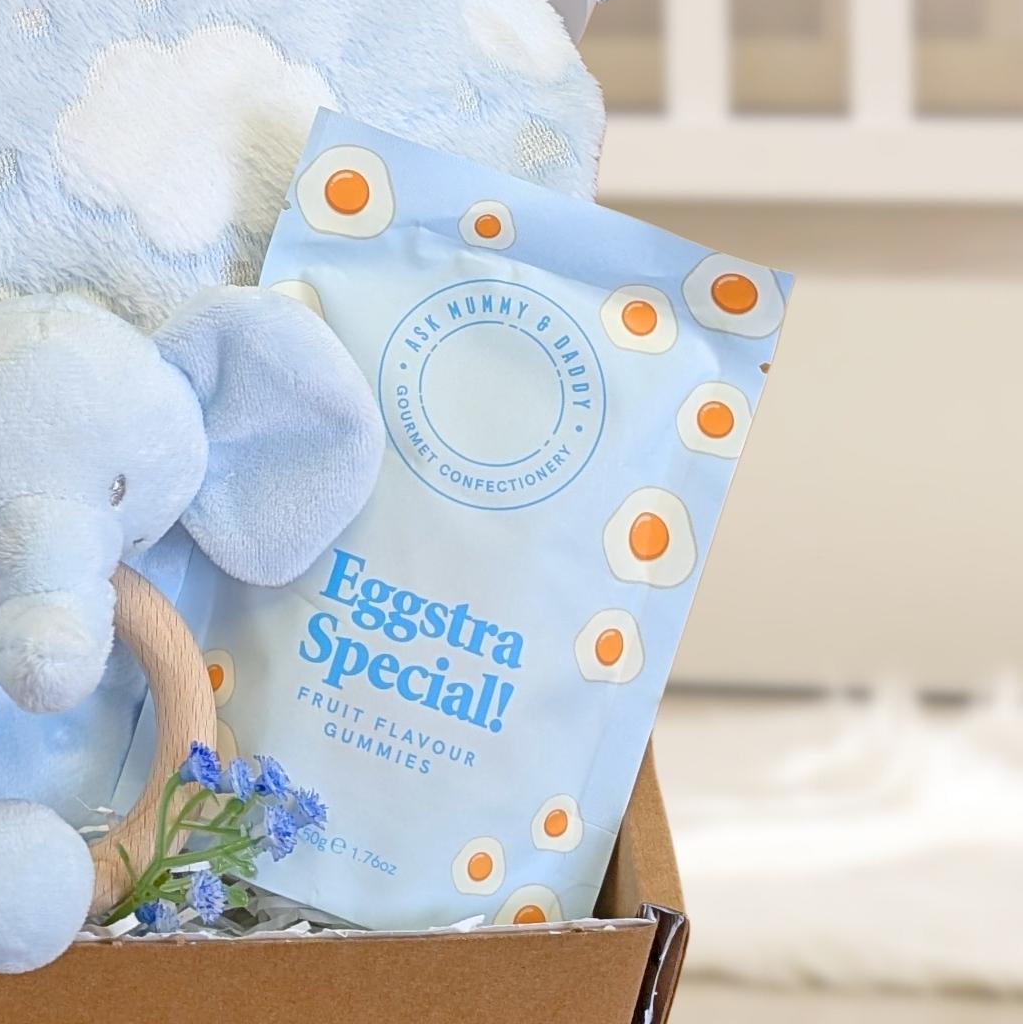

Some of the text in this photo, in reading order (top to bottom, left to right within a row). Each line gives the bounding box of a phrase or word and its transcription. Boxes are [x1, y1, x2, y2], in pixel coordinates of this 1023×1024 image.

[404, 294, 591, 410] ASK MUMMY & DADDY
[396, 384, 572, 493] GOURMET CONFECTIONERY
[319, 547, 524, 669] Eggstra
[297, 685, 477, 768] FRUIT FLAVOUR
[298, 611, 516, 734] Special!
[323, 721, 432, 775] GUMMIES
[352, 847, 398, 876] 1.76oz
